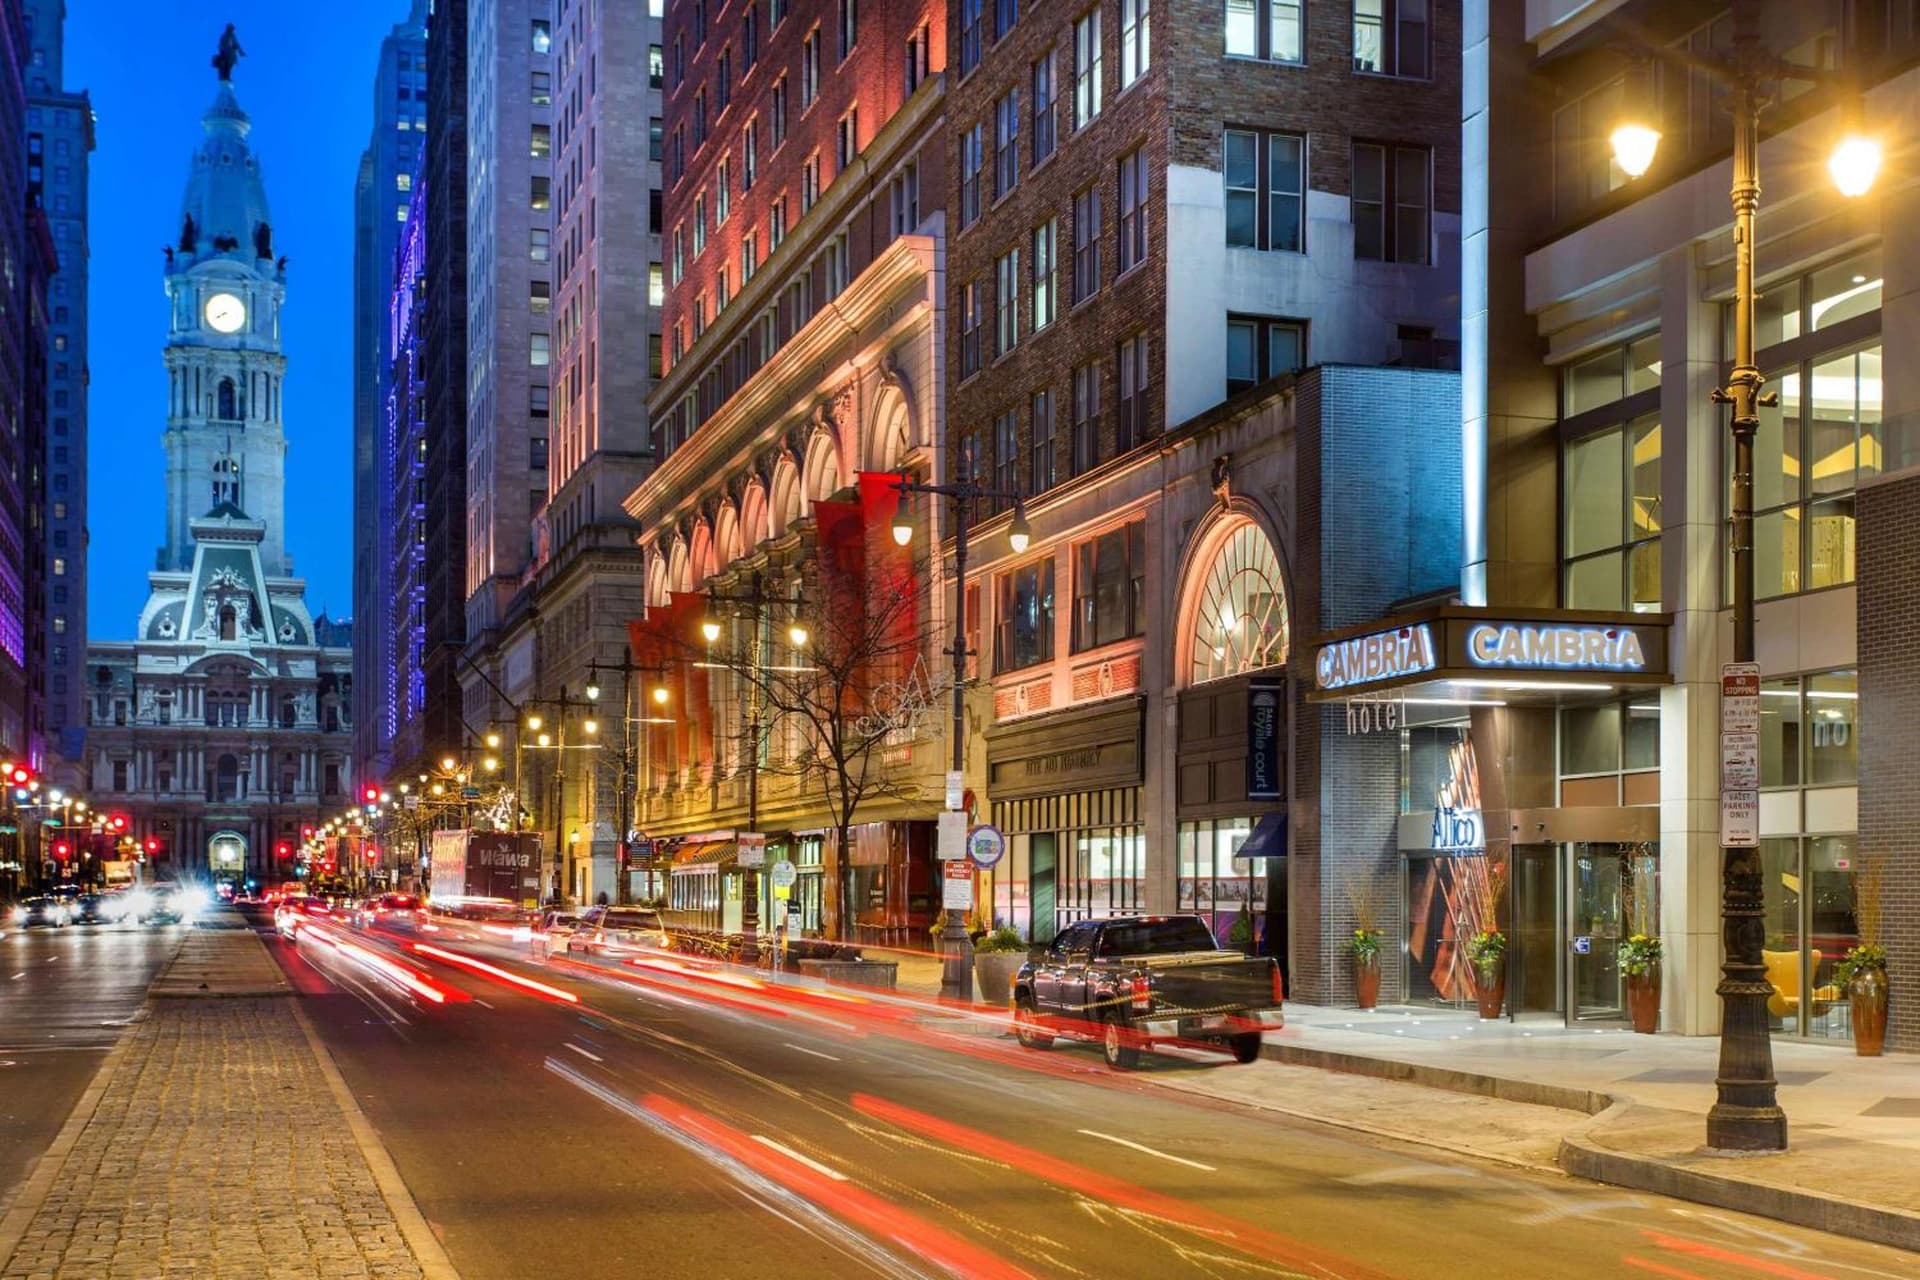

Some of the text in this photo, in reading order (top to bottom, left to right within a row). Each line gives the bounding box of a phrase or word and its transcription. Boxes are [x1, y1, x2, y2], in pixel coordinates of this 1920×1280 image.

[1346, 690, 1406, 736] hotel
[1255, 752, 1269, 789] court
[1728, 792, 1750, 801] VALET
[1723, 802, 1756, 810] PARKING
[1729, 811, 1749, 819] ONLY
[480, 848, 530, 868] Wawa
